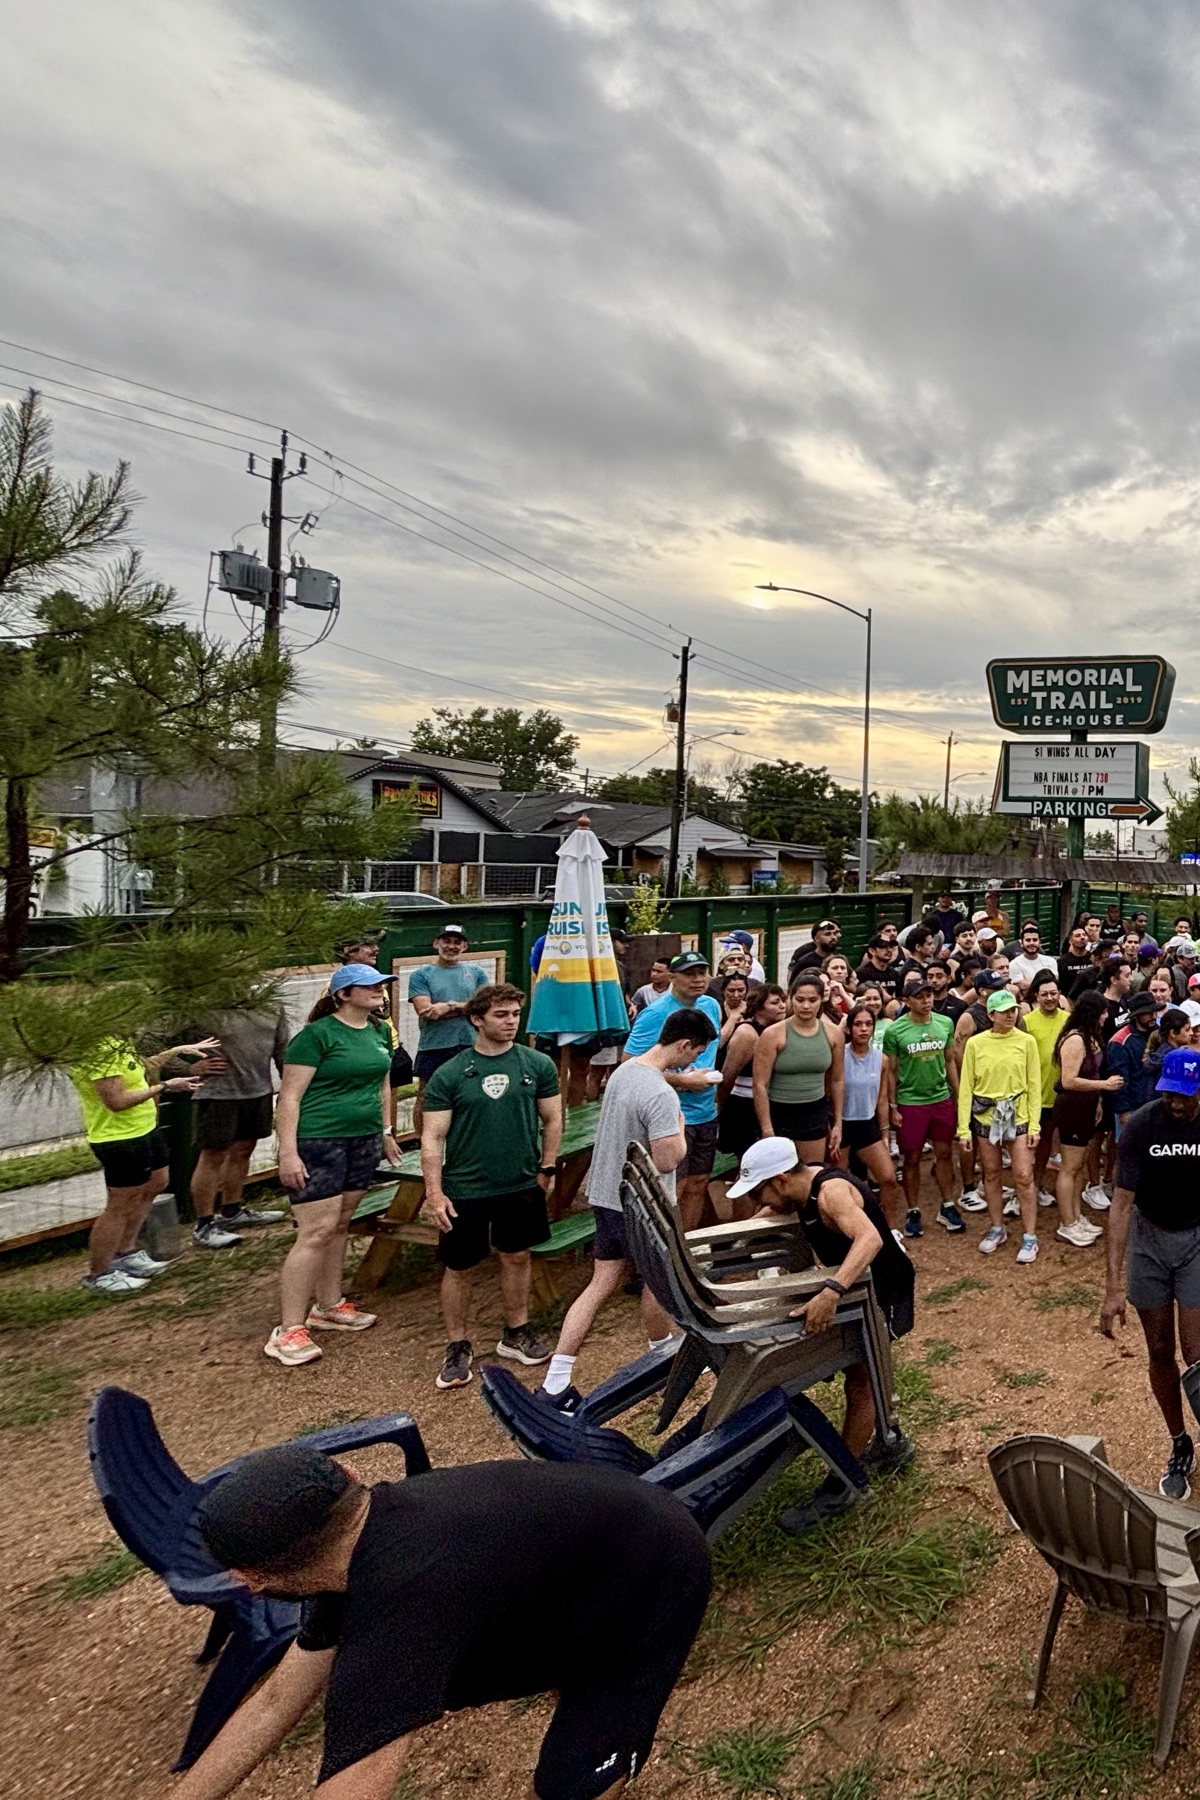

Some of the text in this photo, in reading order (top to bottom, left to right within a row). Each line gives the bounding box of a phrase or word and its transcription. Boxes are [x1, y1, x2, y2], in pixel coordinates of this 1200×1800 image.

[1006, 668, 1142, 694] MEMORIAL
[1031, 690, 1113, 710] TRAIL
[1023, 714, 1124, 726] ICE HOUSE
[1034, 747, 1116, 758] $1 WINGS ALL DAY
[1033, 772, 1109, 783] NBA FINALS AT 730
[1043, 785, 1069, 796] TRIVIA
[1081, 785, 1086, 796] 7
[1088, 785, 1105, 796] PM
[1033, 801, 1107, 816] PARKING
